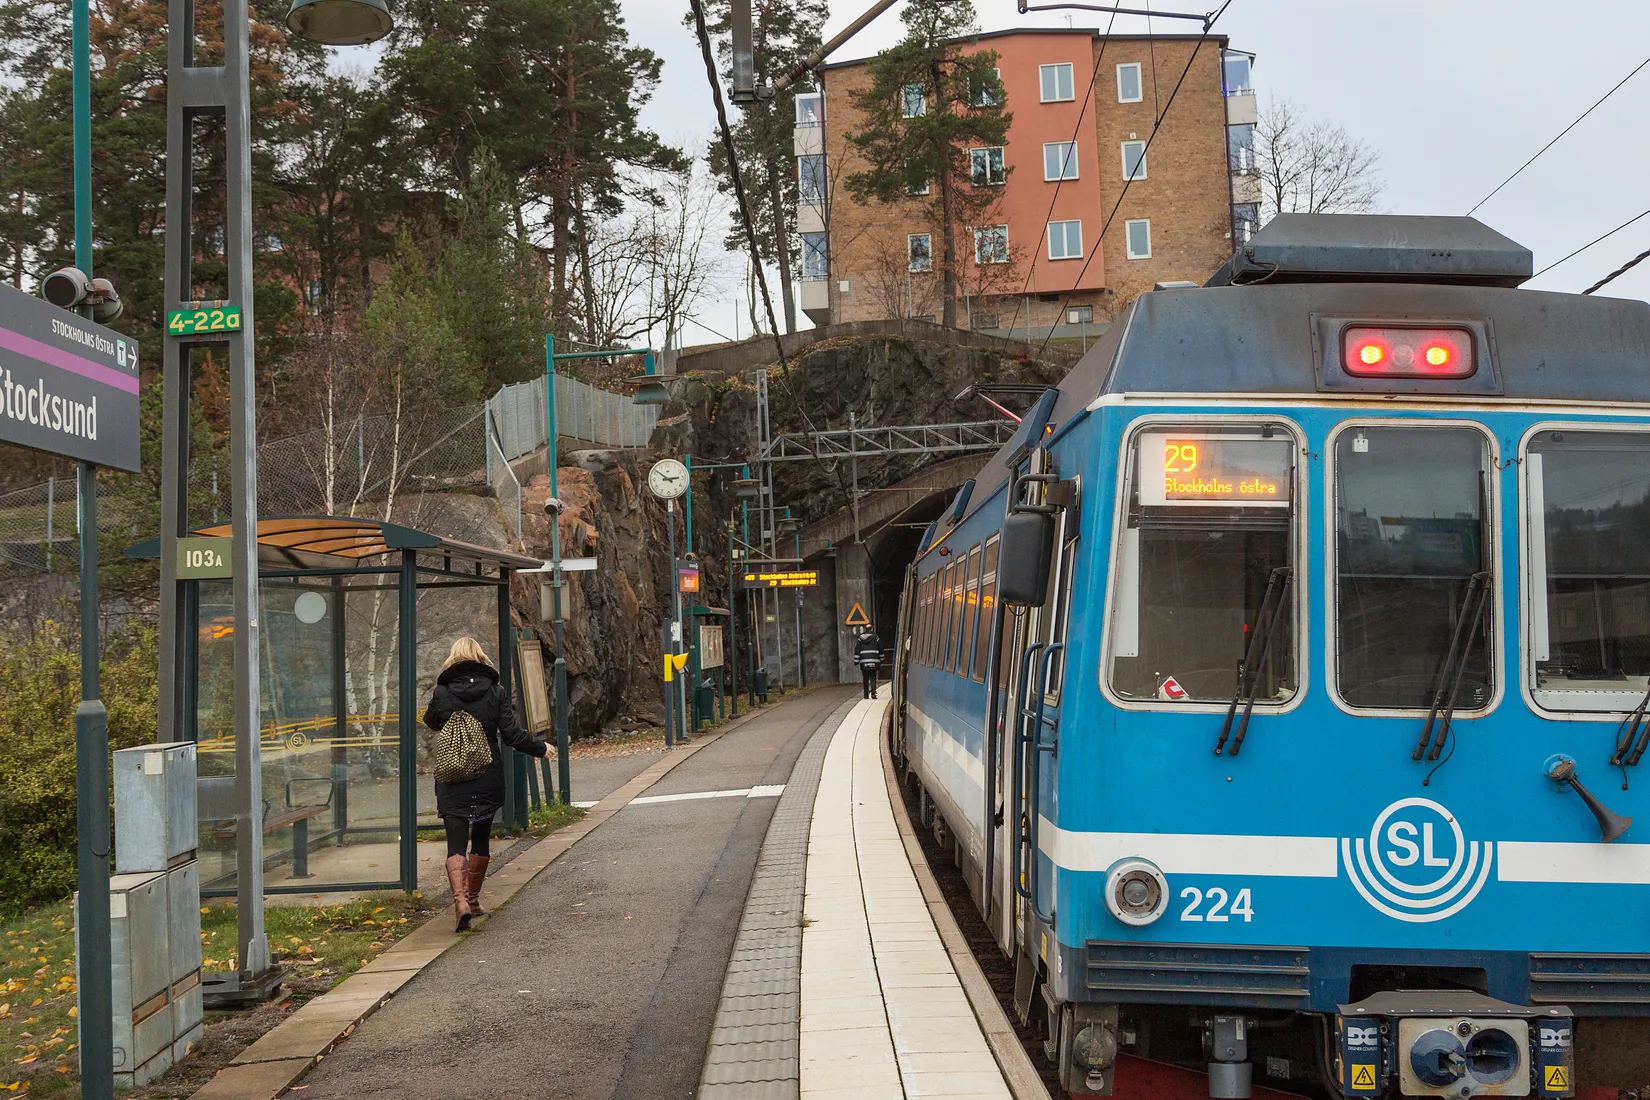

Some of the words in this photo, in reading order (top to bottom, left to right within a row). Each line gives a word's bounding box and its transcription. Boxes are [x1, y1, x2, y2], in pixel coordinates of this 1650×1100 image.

[169, 311, 240, 332] 4-22a
[51, 318, 95, 348] STOCKHOLMS
[95, 335, 115, 356] ÖSTRA
[1165, 445, 1197, 473] 29
[1165, 478, 1233, 493] Stockholms
[1239, 479, 1277, 494] östra
[186, 549, 223, 568] 103A
[292, 736, 304, 745] SL
[1386, 821, 1450, 867] SL
[1179, 886, 1255, 922] 224
